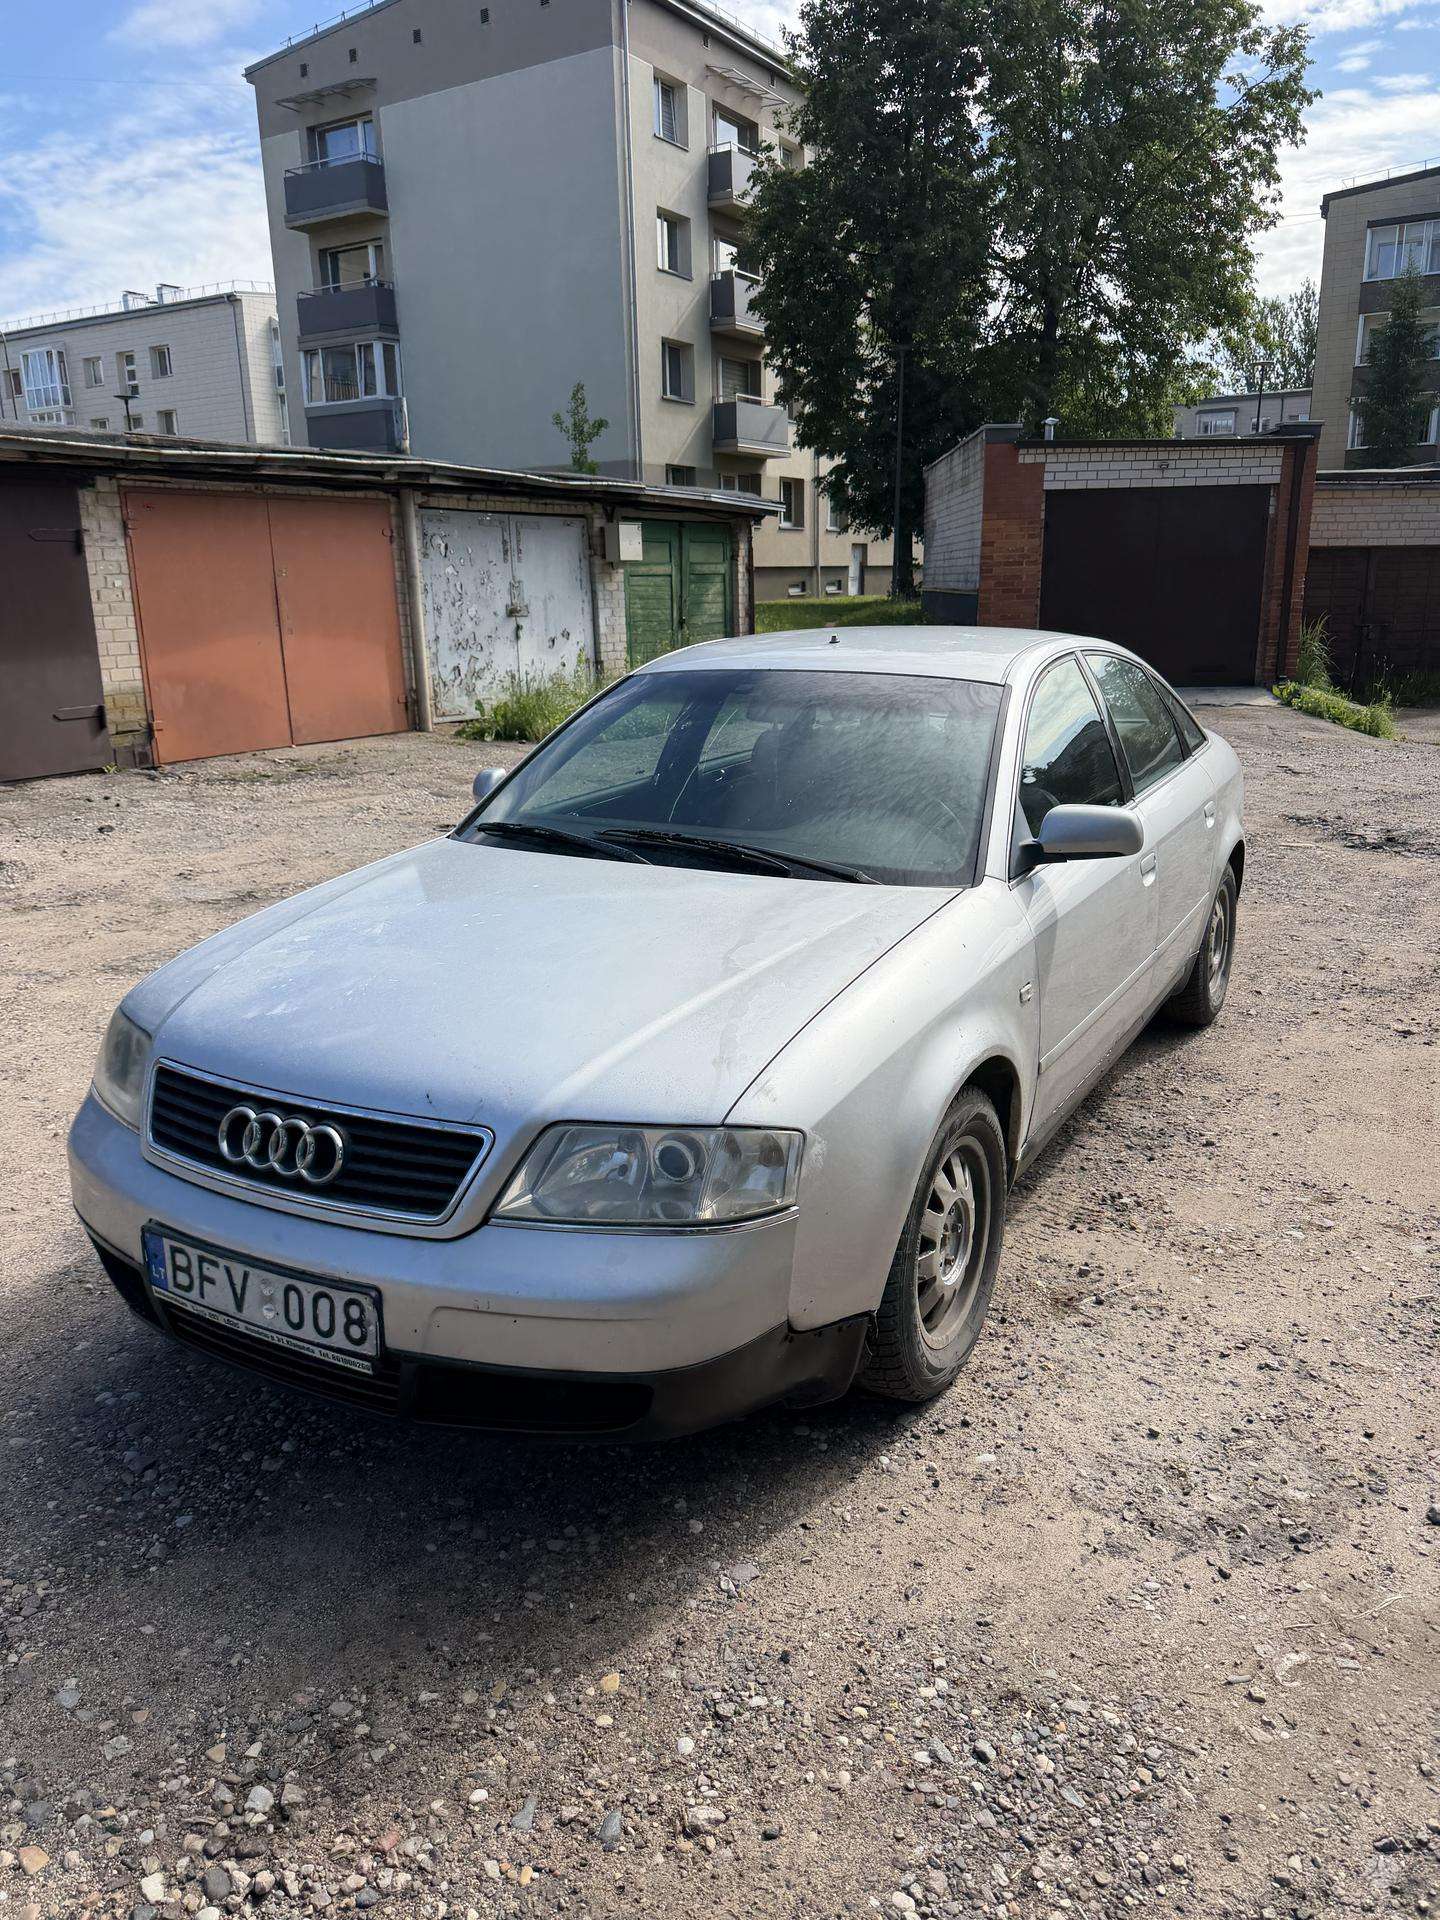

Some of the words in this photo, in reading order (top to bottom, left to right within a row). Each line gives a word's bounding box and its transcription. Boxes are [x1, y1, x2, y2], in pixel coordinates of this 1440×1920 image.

[152, 1267, 167, 1279] LT
[170, 1244, 250, 1313] BFV
[284, 1283, 368, 1346] 008
